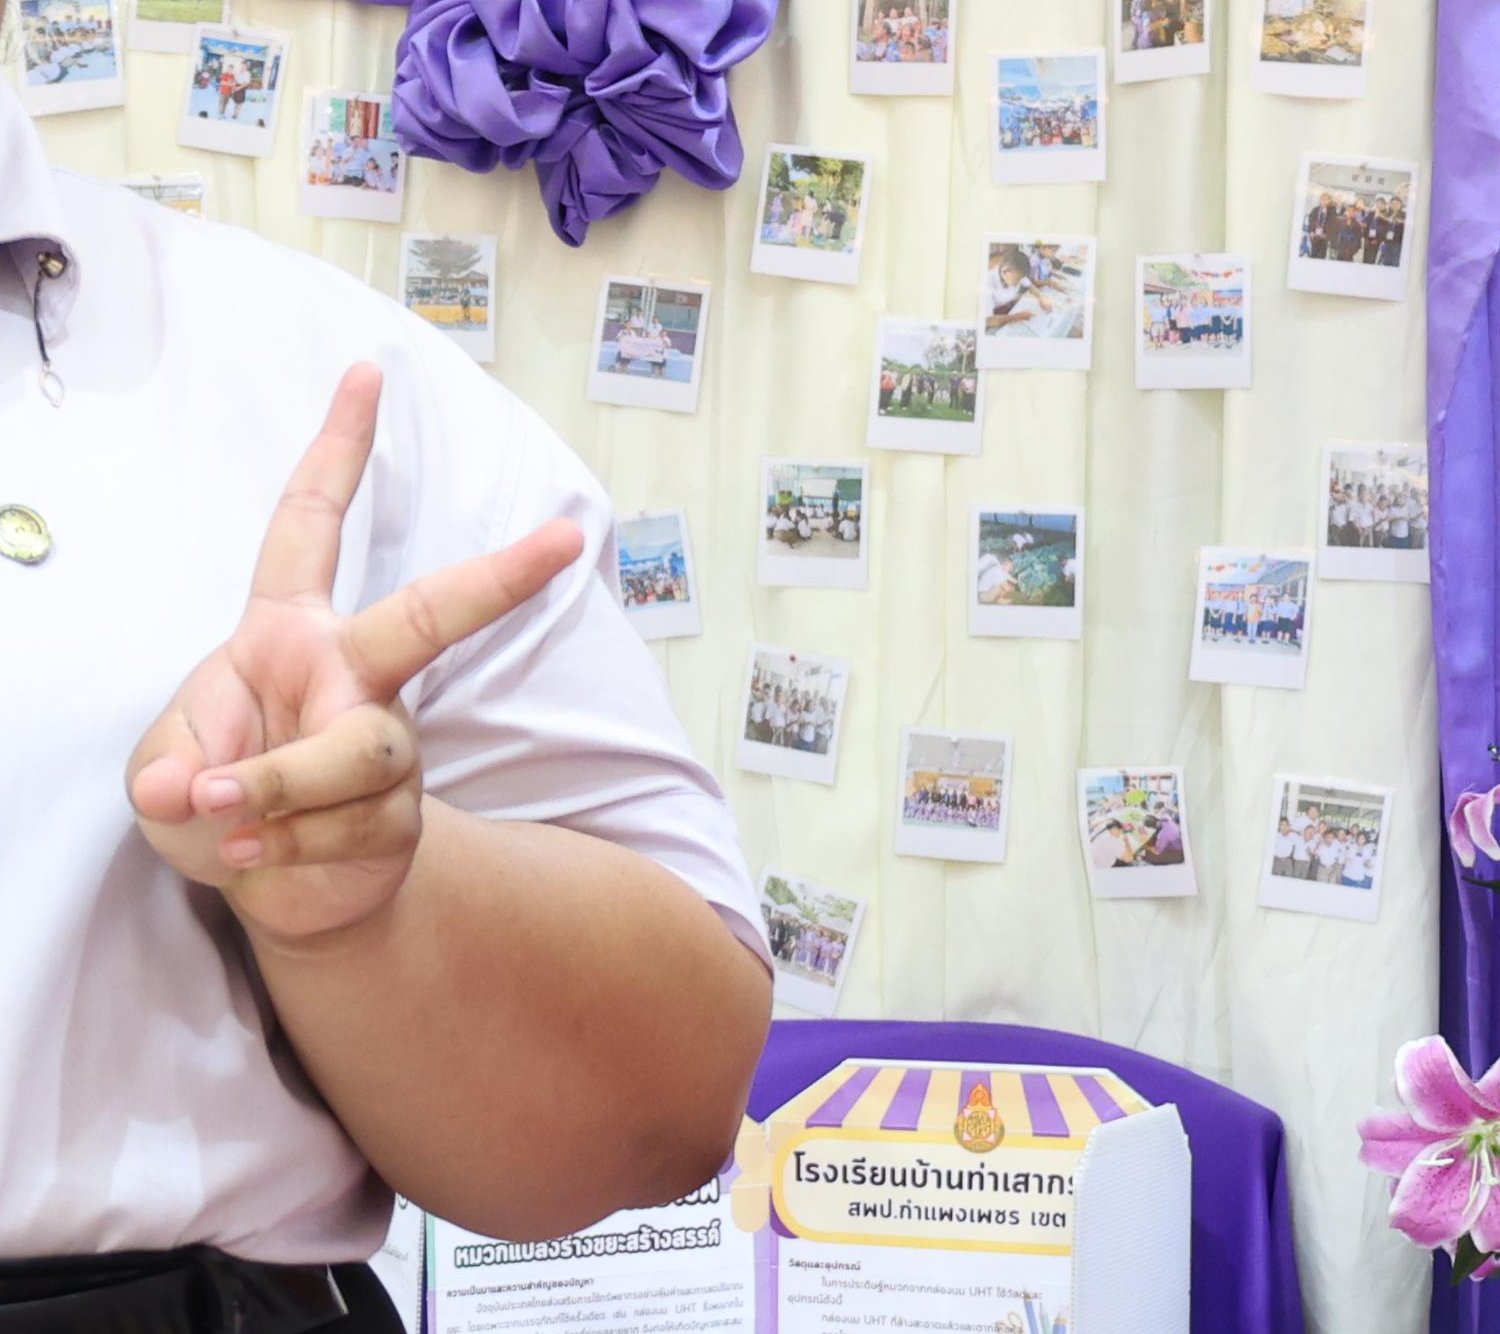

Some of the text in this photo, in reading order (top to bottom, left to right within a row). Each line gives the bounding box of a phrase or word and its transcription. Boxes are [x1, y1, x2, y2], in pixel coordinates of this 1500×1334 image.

[847, 1199, 1067, 1228] สพป.กำแพงเพชร เขต
[968, 1285, 993, 1299] UHT
[675, 1302, 698, 1315] UHT
[863, 1314, 888, 1327] UHT
